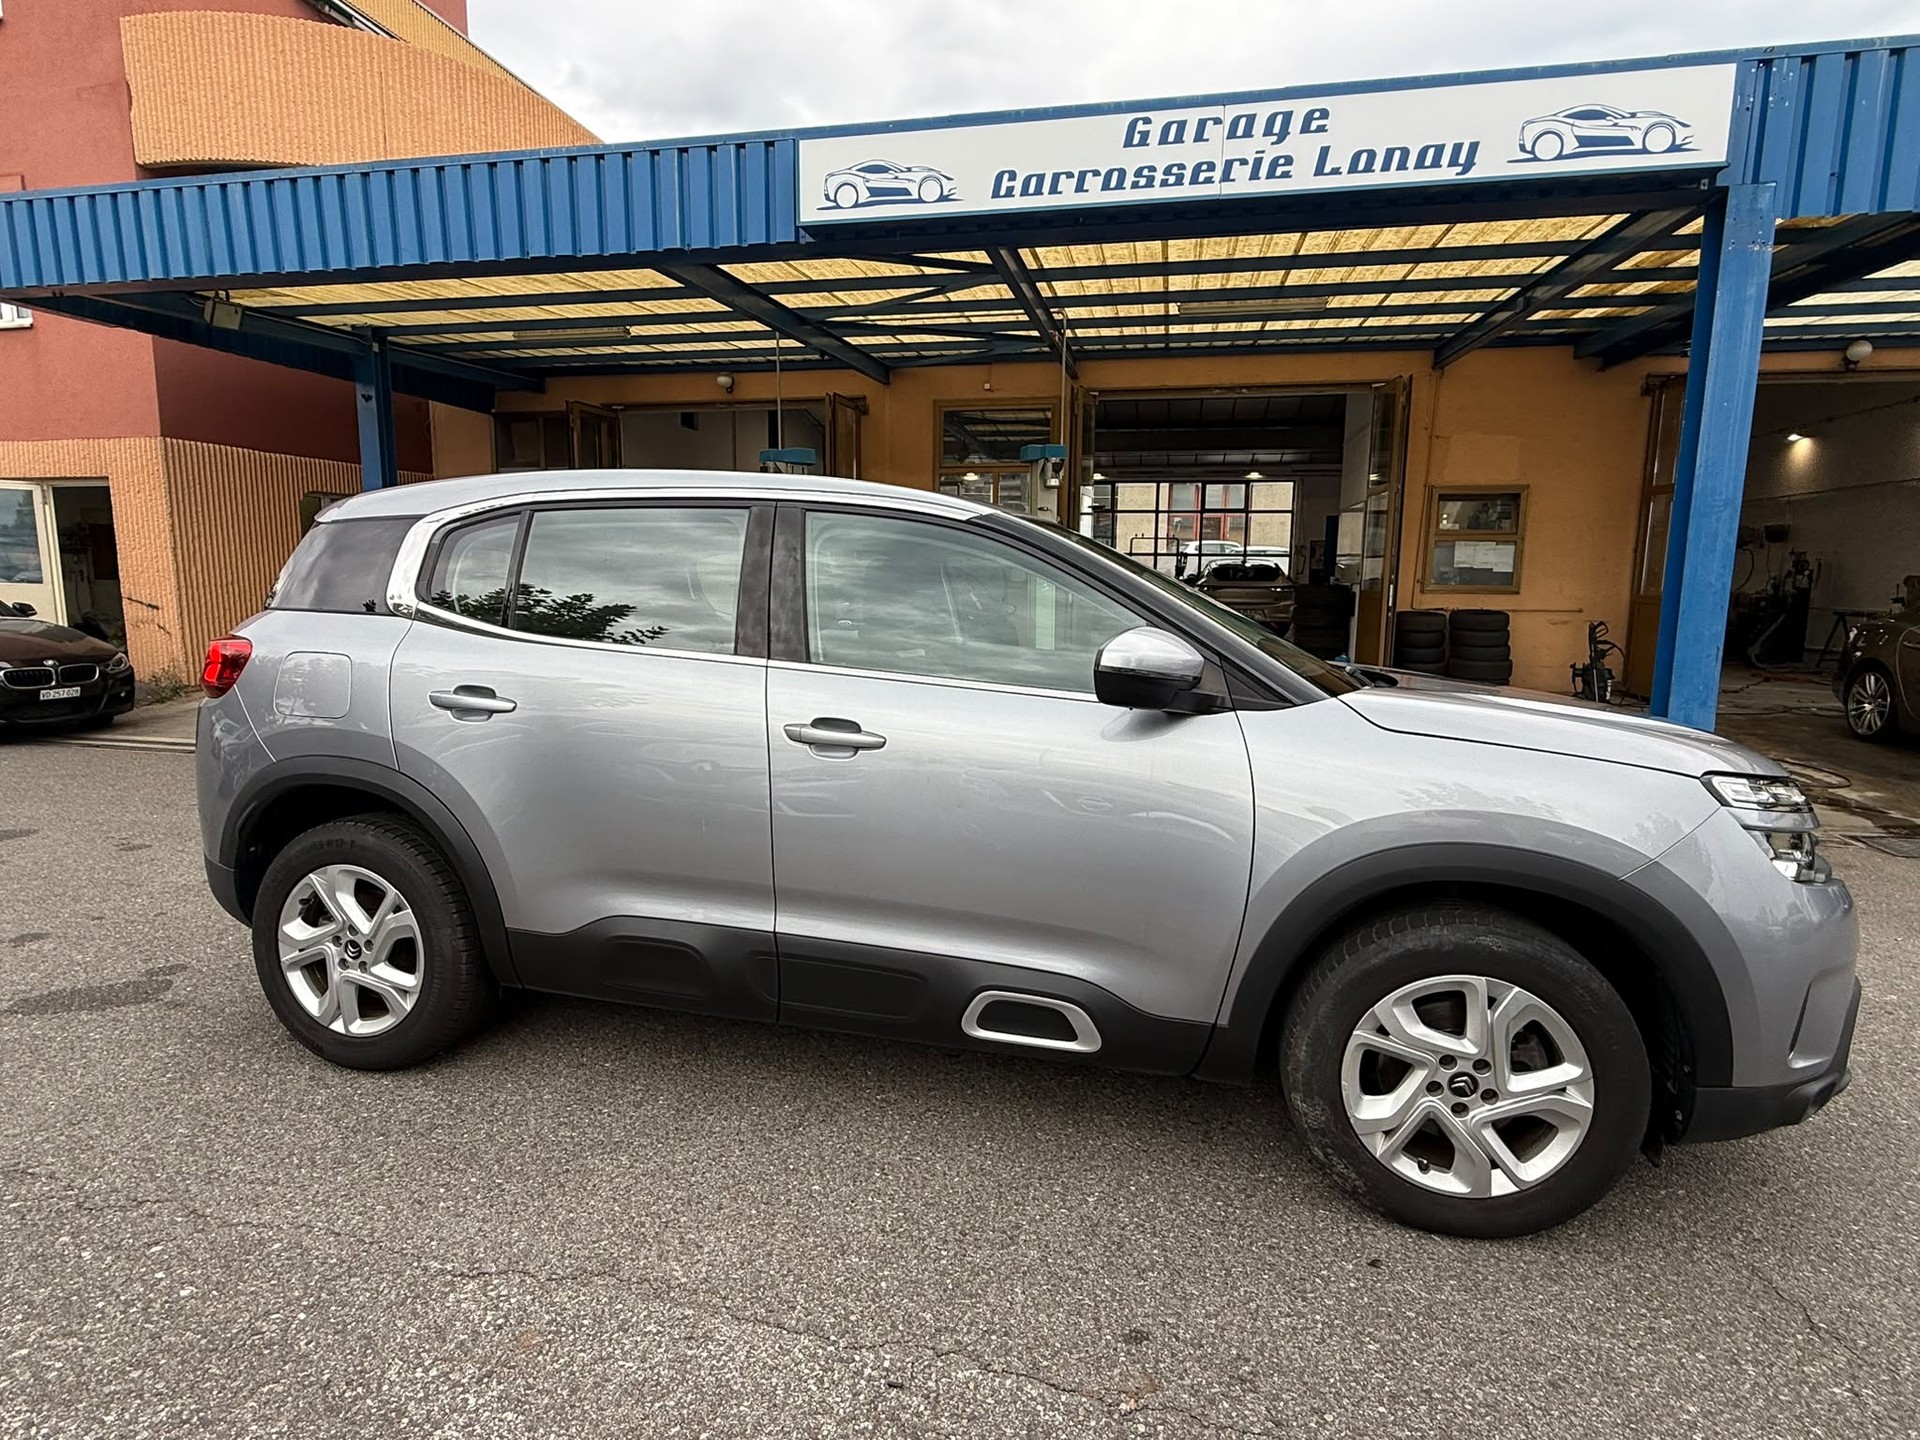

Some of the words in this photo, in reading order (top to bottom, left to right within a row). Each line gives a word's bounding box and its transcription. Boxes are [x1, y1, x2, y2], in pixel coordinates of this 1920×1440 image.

[1123, 107, 1330, 148] Garage
[991, 150, 1294, 199] Carrosserie
[1313, 141, 1480, 177] Lonay
